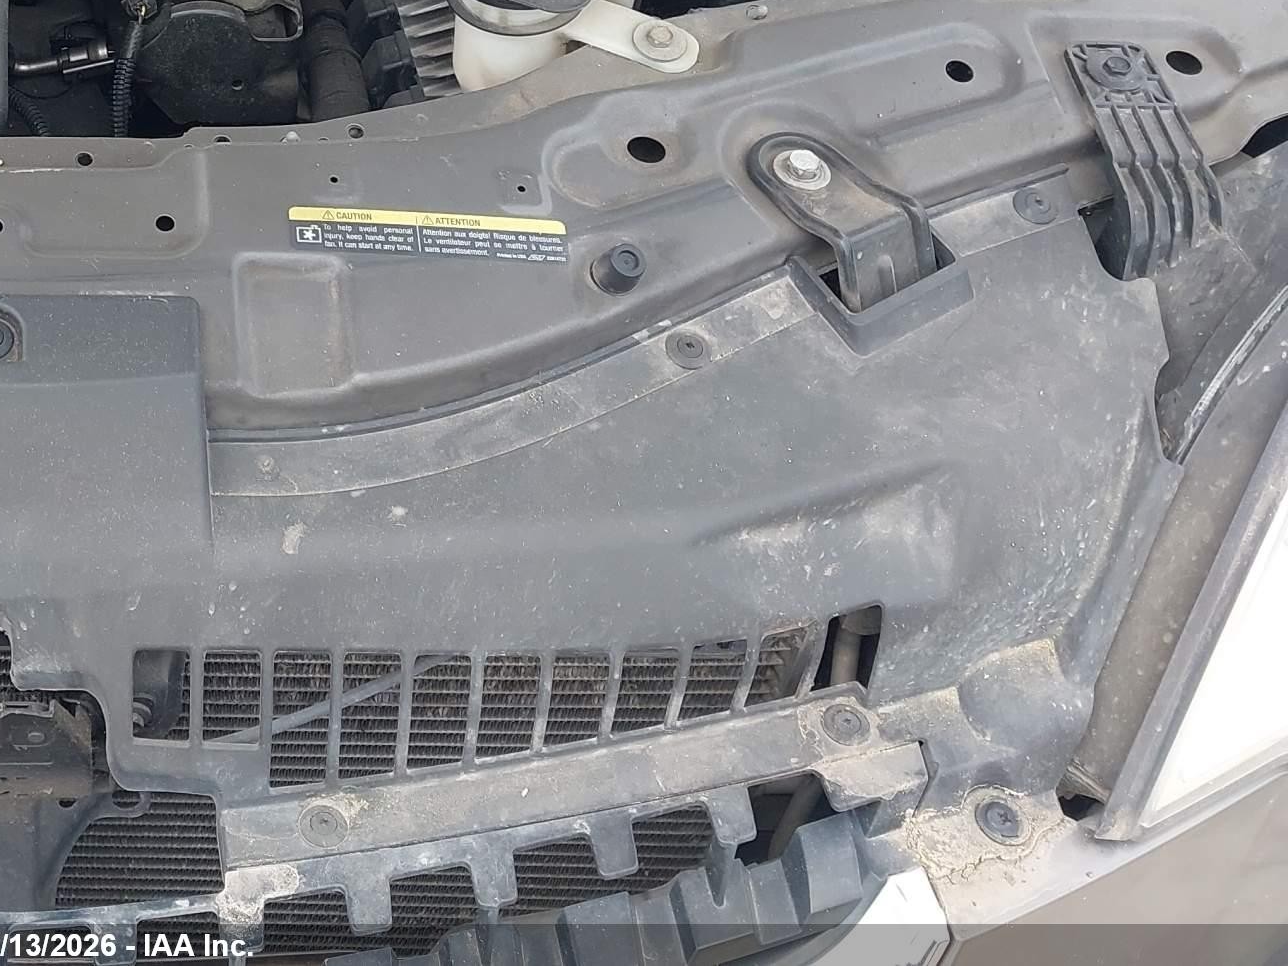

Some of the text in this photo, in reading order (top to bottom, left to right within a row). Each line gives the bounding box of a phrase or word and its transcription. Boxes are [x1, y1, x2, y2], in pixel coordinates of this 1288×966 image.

[336, 211, 372, 221] CAUTION
[435, 217, 481, 227] ATTENTION
[337, 224, 353, 232] help
[359, 225, 377, 233] avoid
[383, 227, 414, 235] personal
[324, 232, 344, 241] injury,
[346, 233, 363, 241] keep
[388, 235, 404, 243] clear
[422, 228, 452, 237] Attention
[493, 232, 516, 242] Risque
[383, 244, 395, 252] any
[435, 239, 471, 247] ventilateur
[475, 241, 490, 249] peut
[505, 242, 528, 250] mettre
[540, 244, 564, 252] tourner
[441, 247, 489, 257] avertissement.
